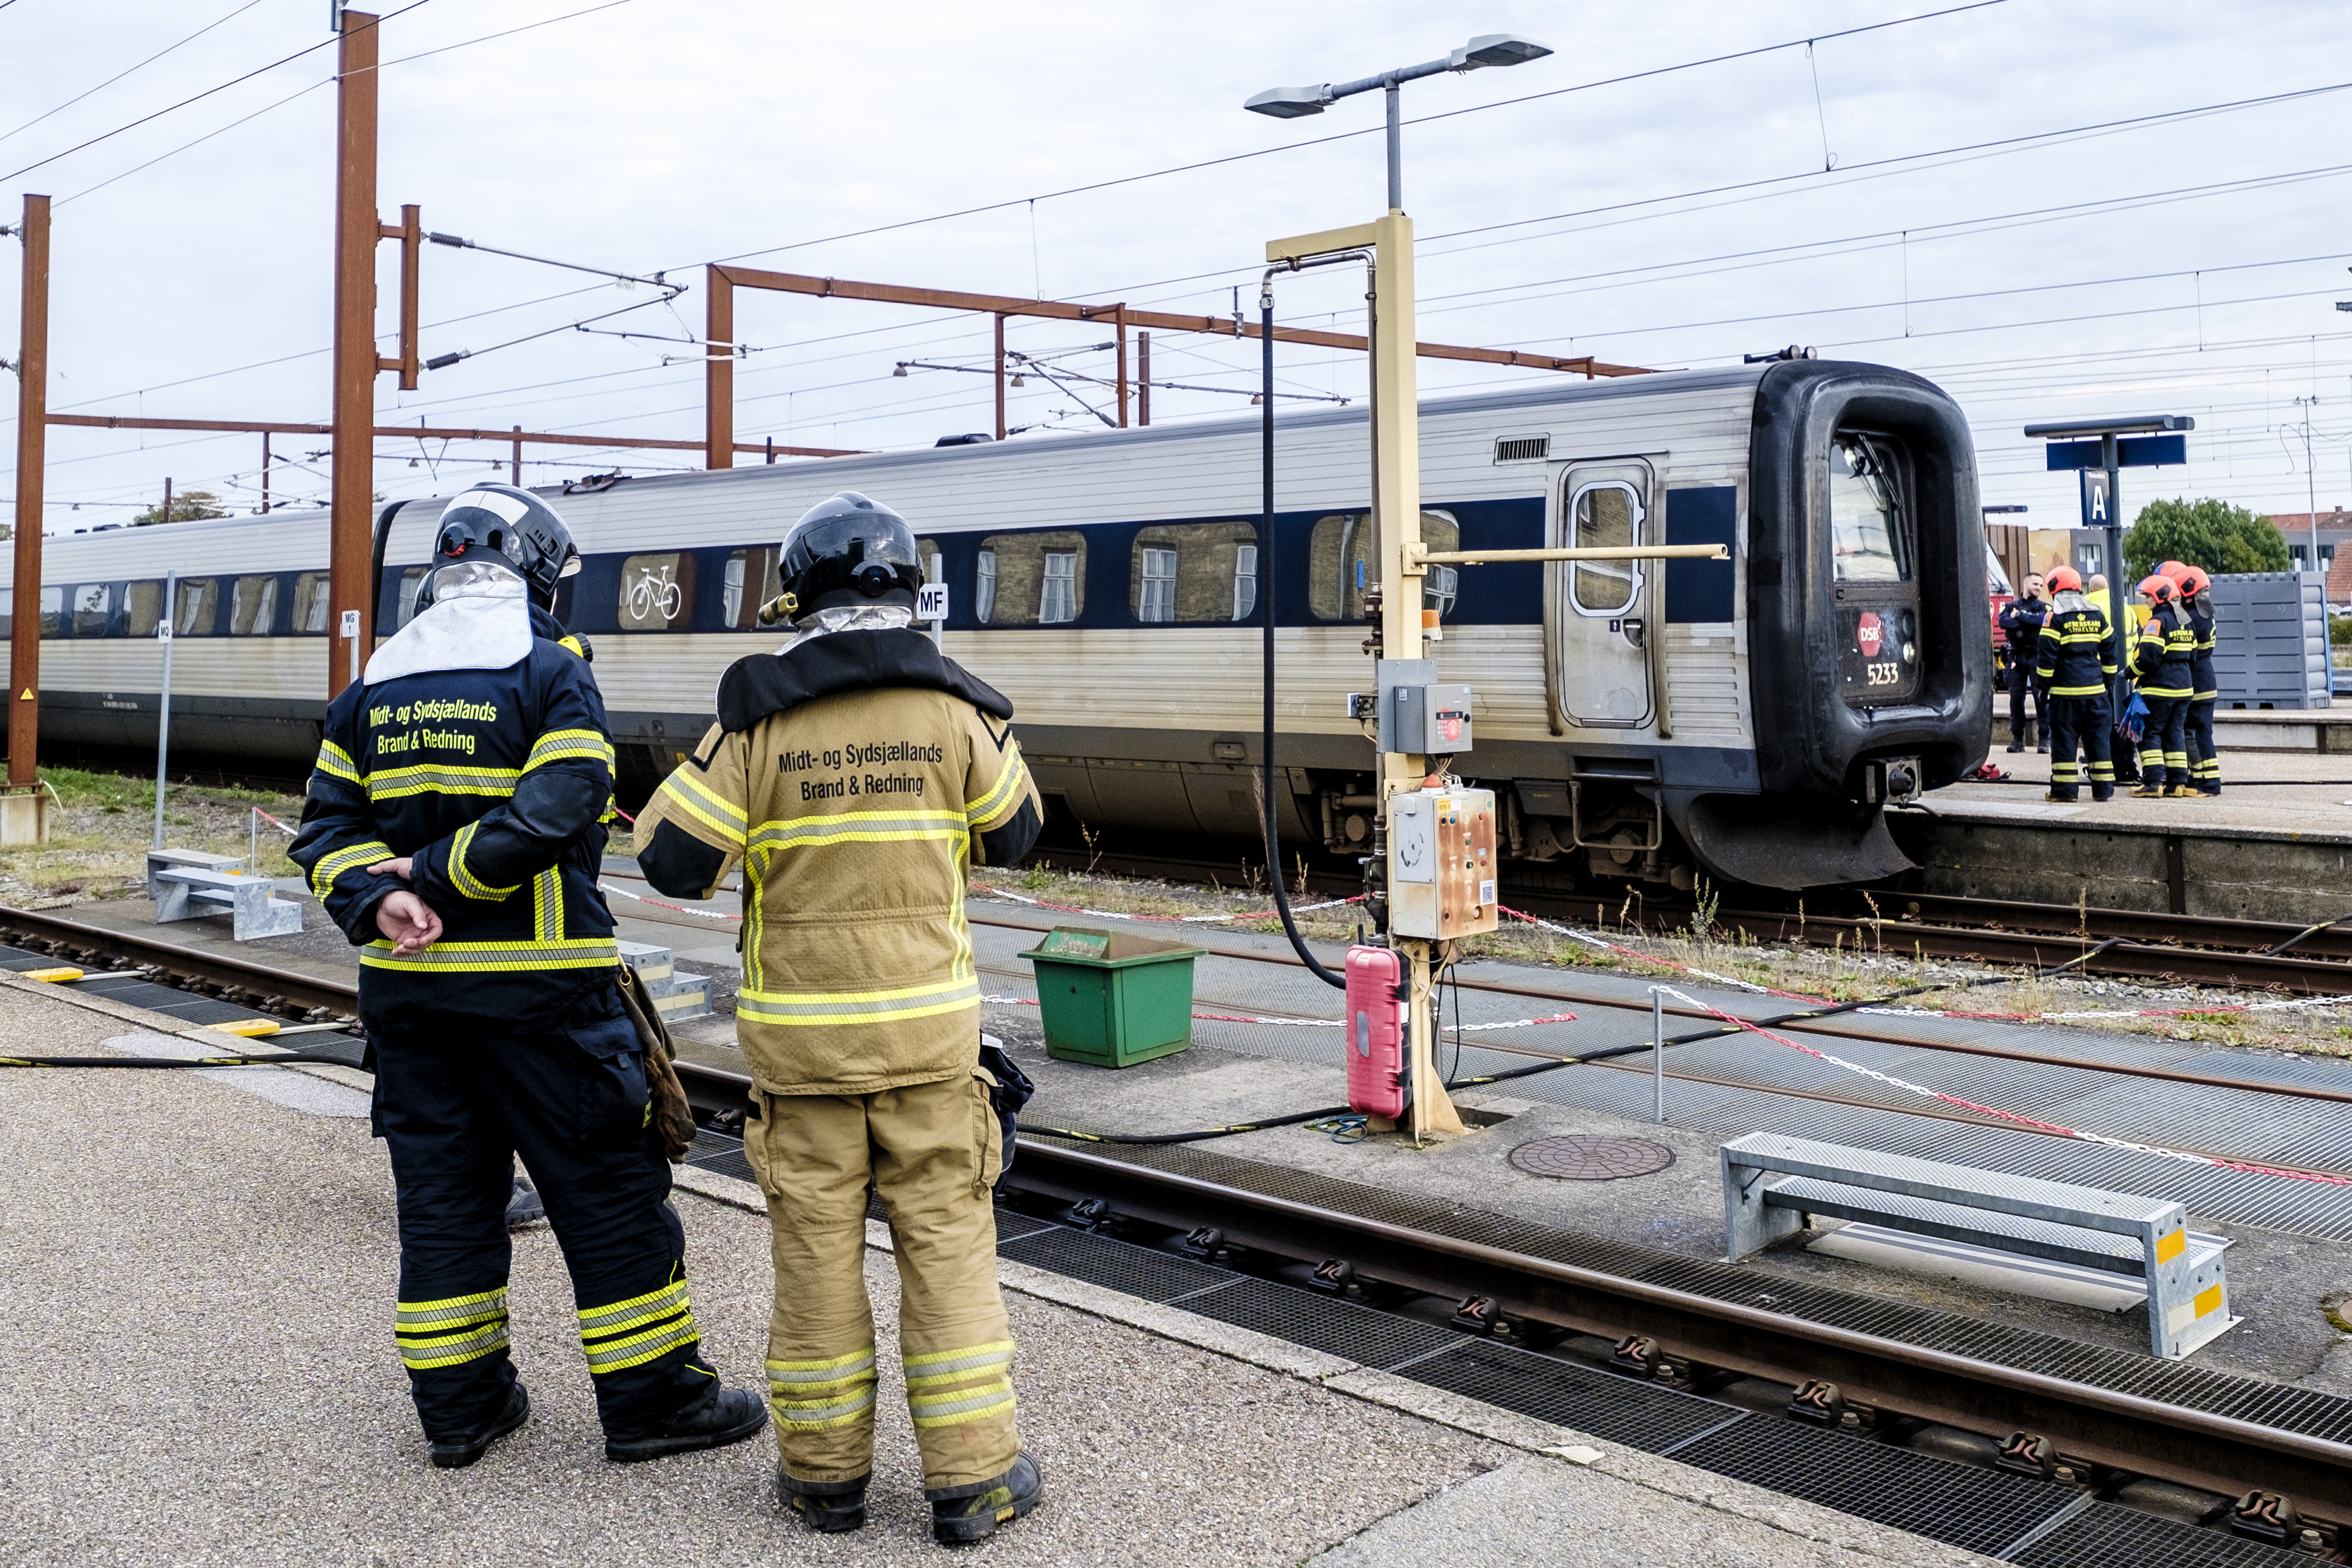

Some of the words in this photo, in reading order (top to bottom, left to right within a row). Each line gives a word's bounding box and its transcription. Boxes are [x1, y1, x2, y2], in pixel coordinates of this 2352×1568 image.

[2092, 486, 2106, 520] A
[920, 591, 943, 612] MF
[345, 613, 355, 623] MG
[348, 624, 351, 634] 1
[1860, 627, 1879, 641] DSB
[1867, 663, 1899, 686] 5233
[369, 706, 393, 727] Midt-
[396, 706, 411, 725] og
[413, 699, 497, 723] Sydsjællands
[377, 731, 409, 754] Brand
[410, 730, 420, 749] &
[422, 729, 475, 755] Redning
[779, 750, 818, 773] Midt-
[823, 750, 841, 770] og
[846, 741, 943, 768] Sydsjællands
[800, 777, 844, 801] Brand
[849, 775, 860, 795] &
[864, 773, 924, 797] Redning
